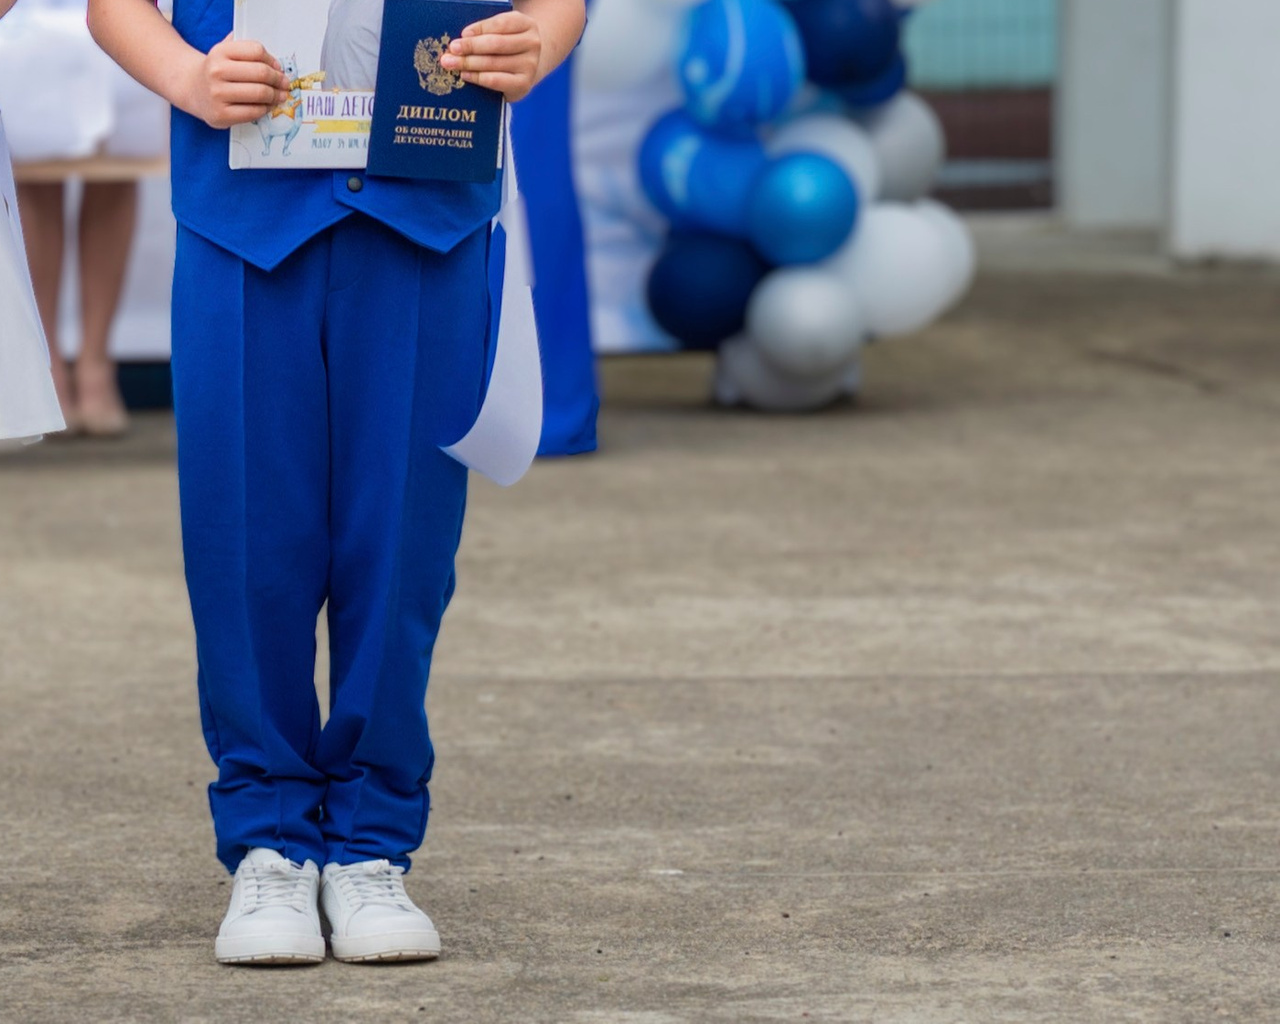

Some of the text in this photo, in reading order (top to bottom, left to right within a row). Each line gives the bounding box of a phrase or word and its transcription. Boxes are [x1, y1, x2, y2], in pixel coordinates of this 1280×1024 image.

[306, 95, 335, 116] НАШ
[396, 105, 477, 123] ДИПЛОМ
[395, 125, 473, 139] ОБ ОКОНЧАНИИ
[393, 135, 473, 148] ДЕТСКОГО САДА
